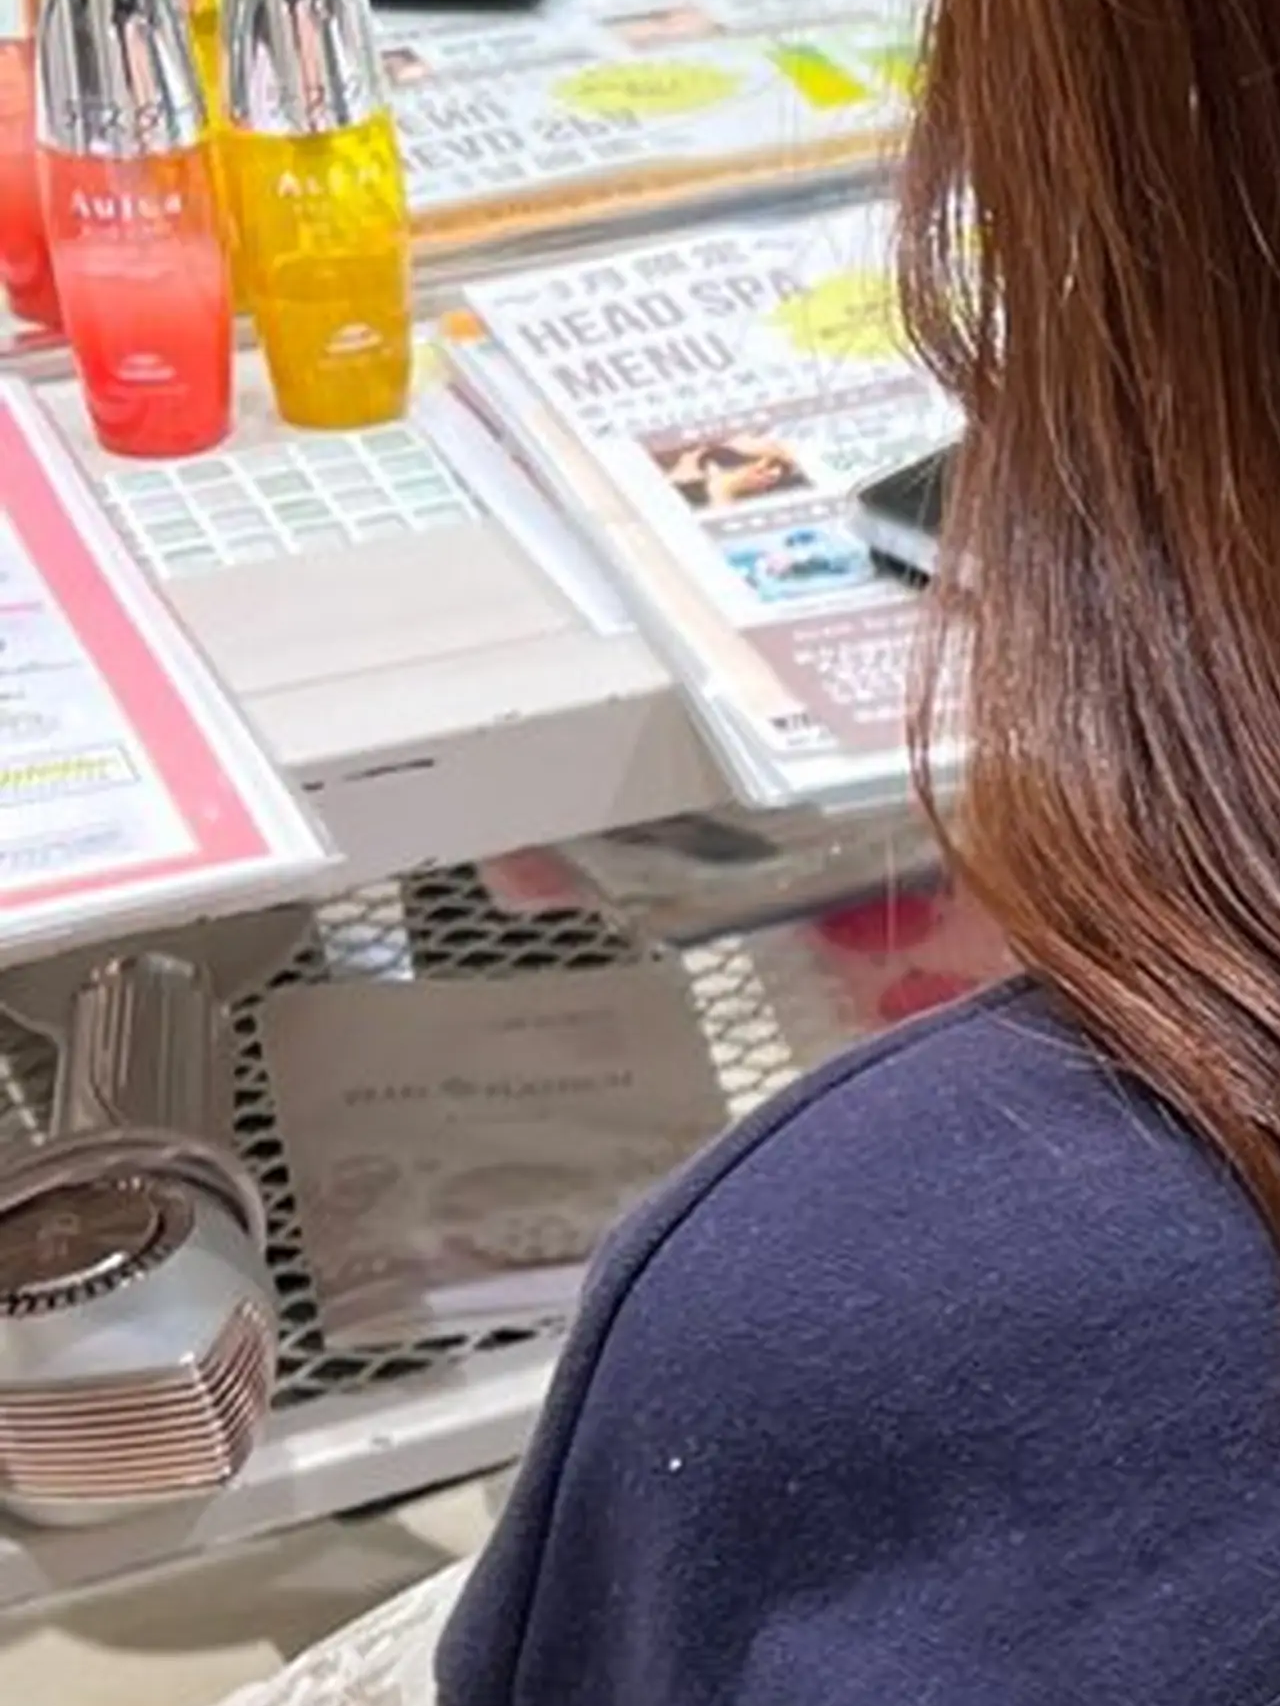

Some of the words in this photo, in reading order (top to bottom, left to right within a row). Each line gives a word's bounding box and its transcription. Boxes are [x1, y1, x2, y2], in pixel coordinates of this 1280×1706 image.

[516, 289, 688, 359] HEAD
[688, 267, 806, 319] SPA
[551, 329, 736, 401] MENU
